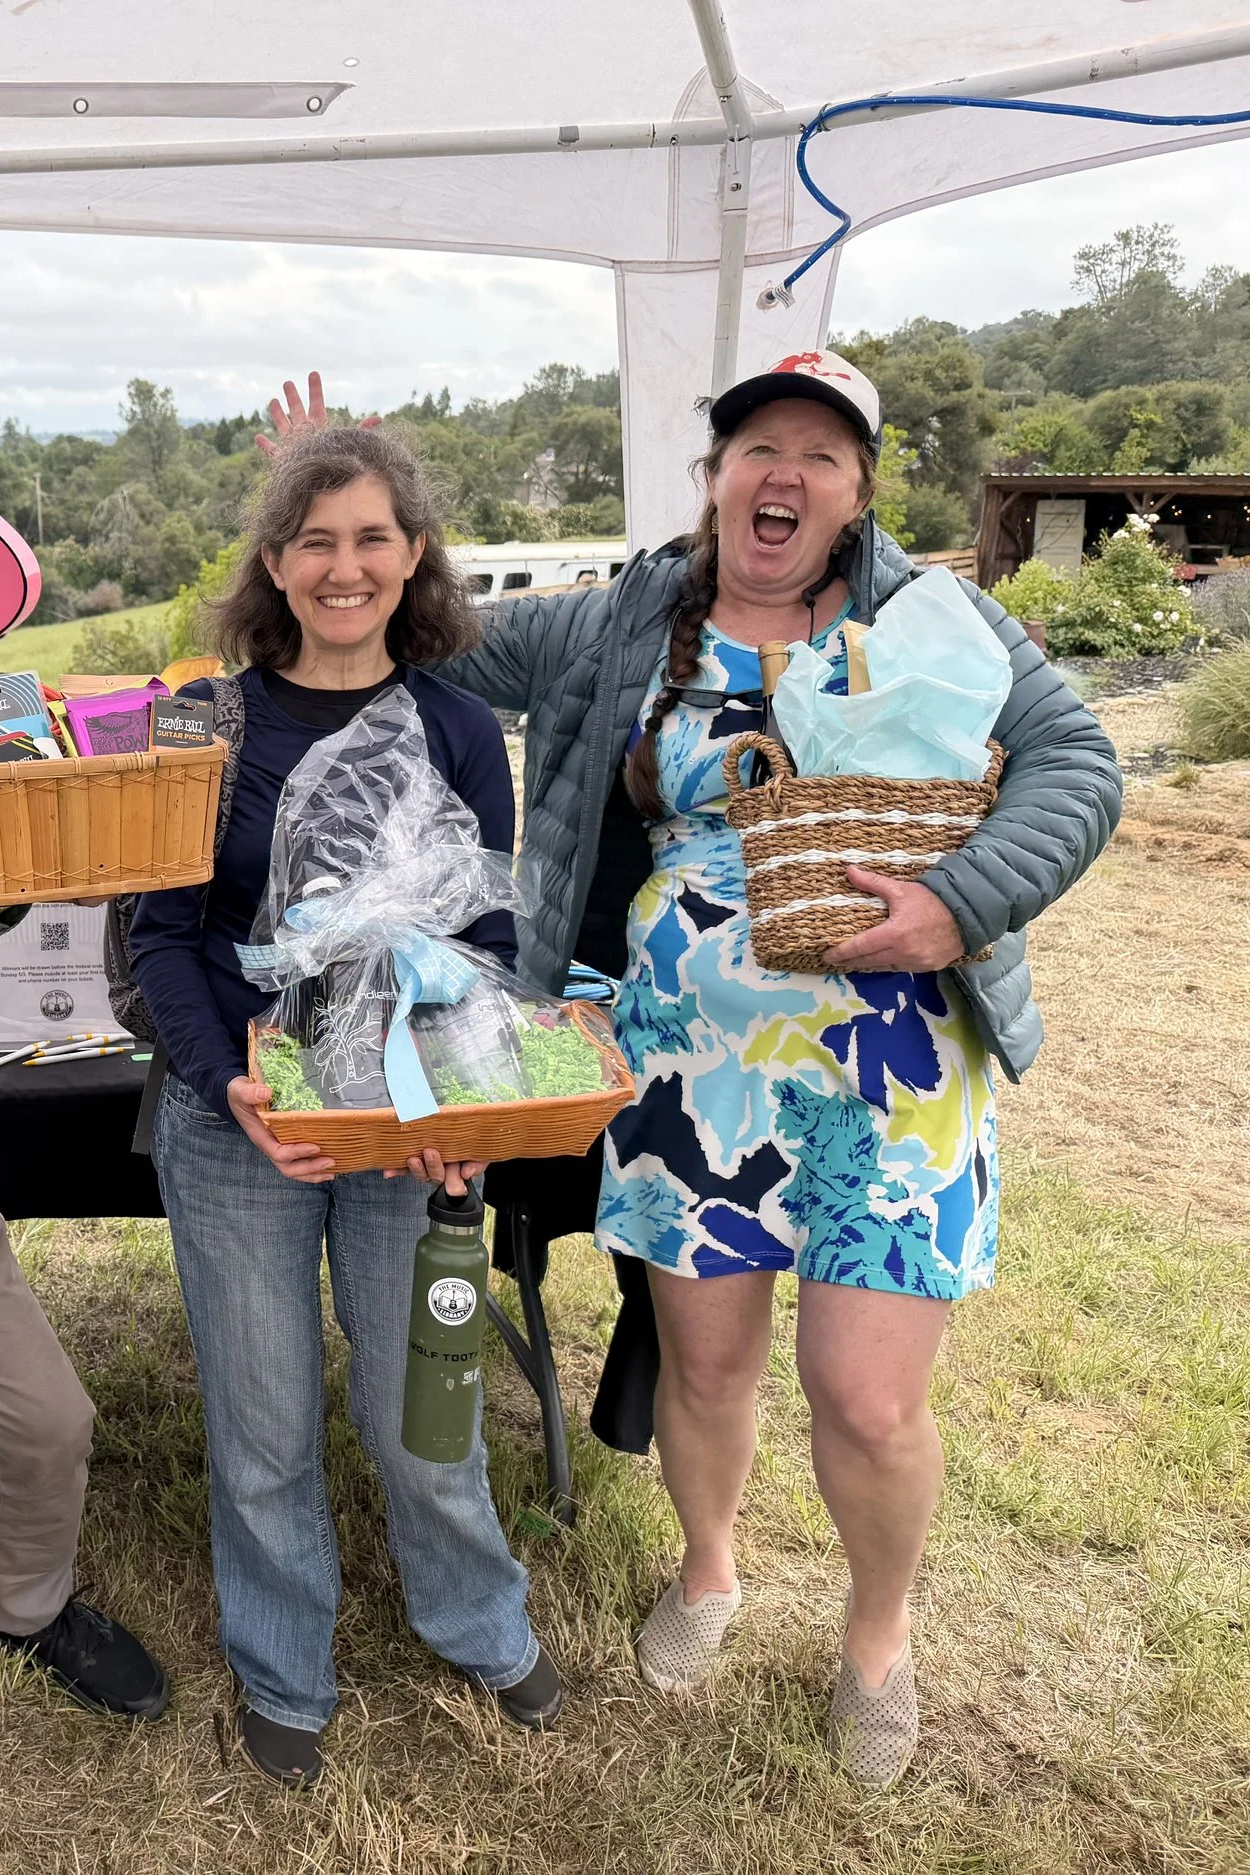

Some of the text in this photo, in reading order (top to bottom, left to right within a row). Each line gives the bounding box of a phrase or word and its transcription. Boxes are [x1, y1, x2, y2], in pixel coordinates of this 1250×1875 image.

[157, 716, 206, 733] ERNIE BALL
[156, 730, 206, 742] GUITAR PICKS
[113, 734, 147, 751] POW
[438, 1284, 469, 1294] THE MUSIC
[440, 1309, 468, 1319] LIBRARY
